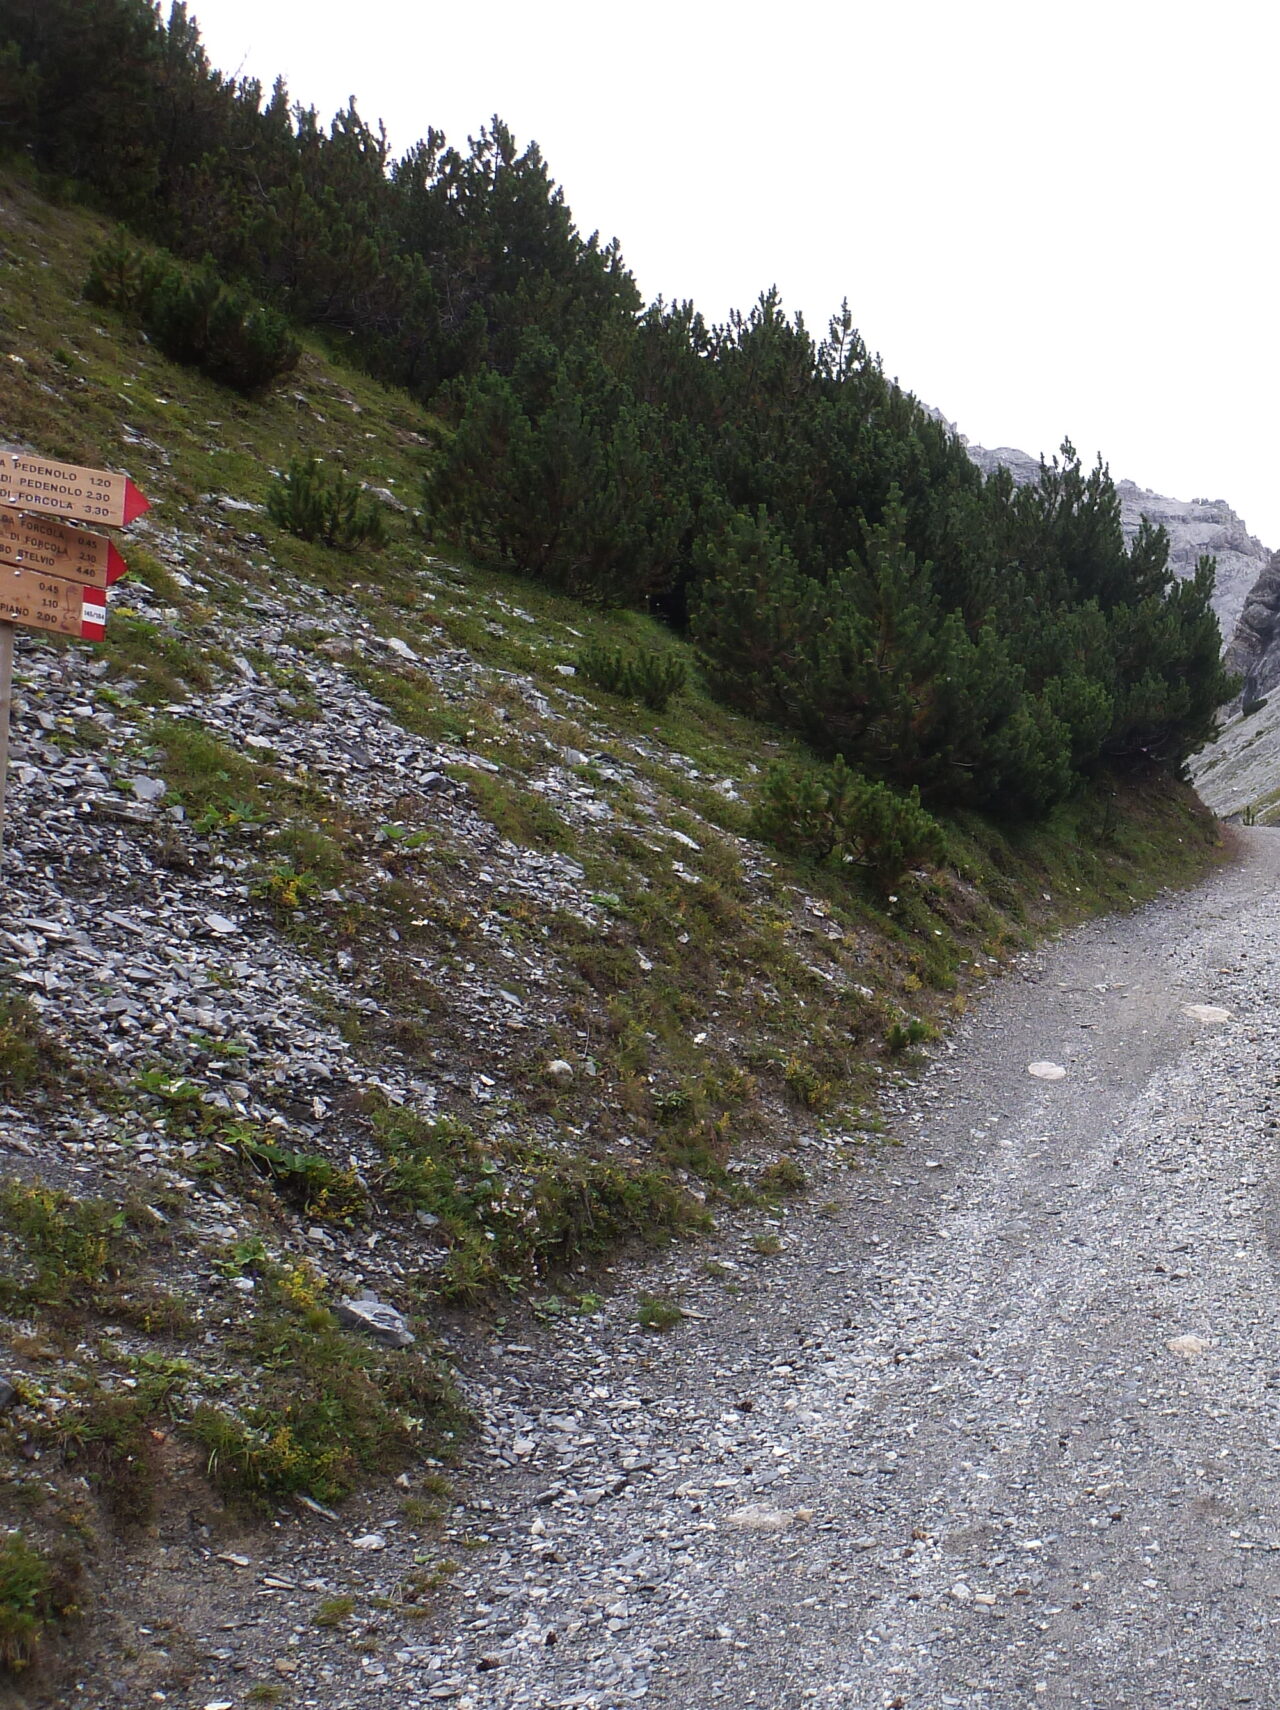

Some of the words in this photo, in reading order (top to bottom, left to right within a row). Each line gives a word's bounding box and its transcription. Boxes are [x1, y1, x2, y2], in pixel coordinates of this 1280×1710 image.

[14, 460, 77, 482] PEDENOLO
[90, 477, 112, 488] 1.20
[0, 474, 12, 484] DI
[20, 477, 82, 497] PEDENOLO
[86, 491, 110, 502] 2.30
[0, 489, 10, 498] DI
[19, 492, 73, 510] FORCOLA
[85, 505, 109, 516] 3.30
[21, 520, 65, 540] FORCOLA
[10, 532, 20, 542] DI
[25, 537, 68, 555] FORCOLA
[17, 549, 55, 566] STELVIO
[39, 582, 59, 594] 0.45
[0, 604, 29, 616] PIANO
[37, 611, 57, 623] 2.00
